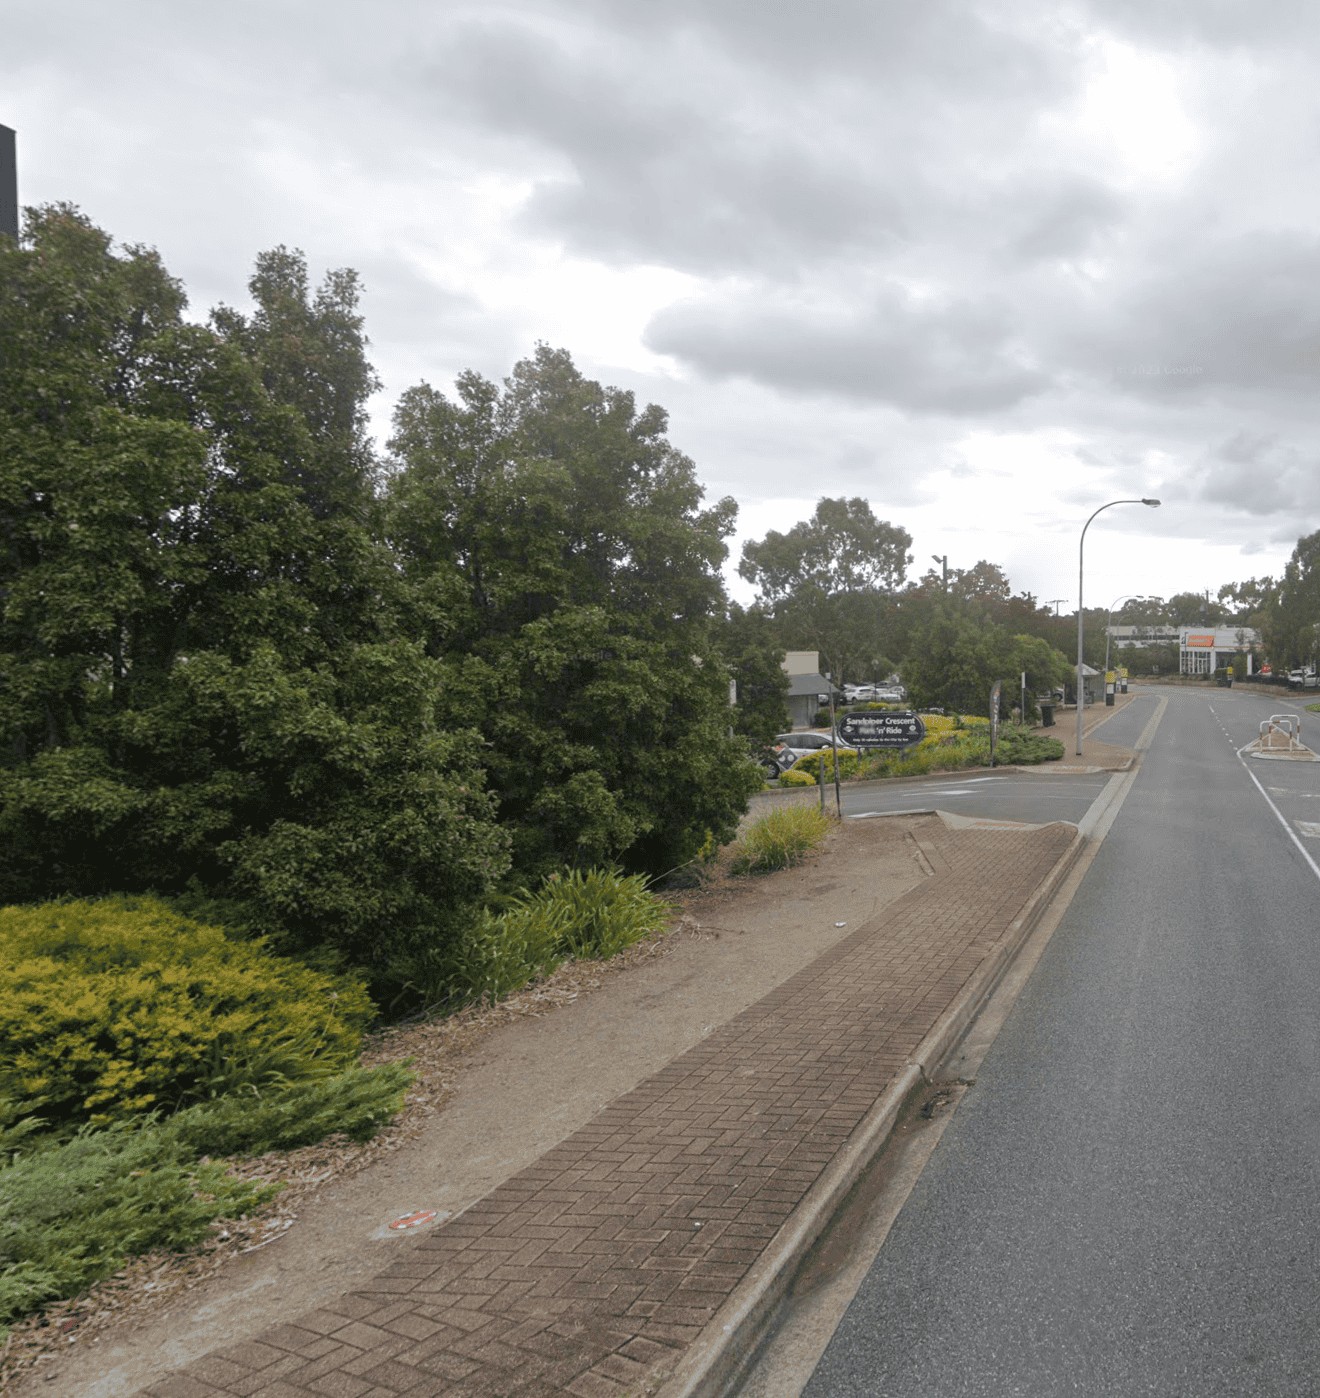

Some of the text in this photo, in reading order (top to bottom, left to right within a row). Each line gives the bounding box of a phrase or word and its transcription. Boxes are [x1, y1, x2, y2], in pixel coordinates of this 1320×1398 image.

[846, 717, 916, 727] Sandpiper Crescent
[886, 726, 903, 735] Ride
